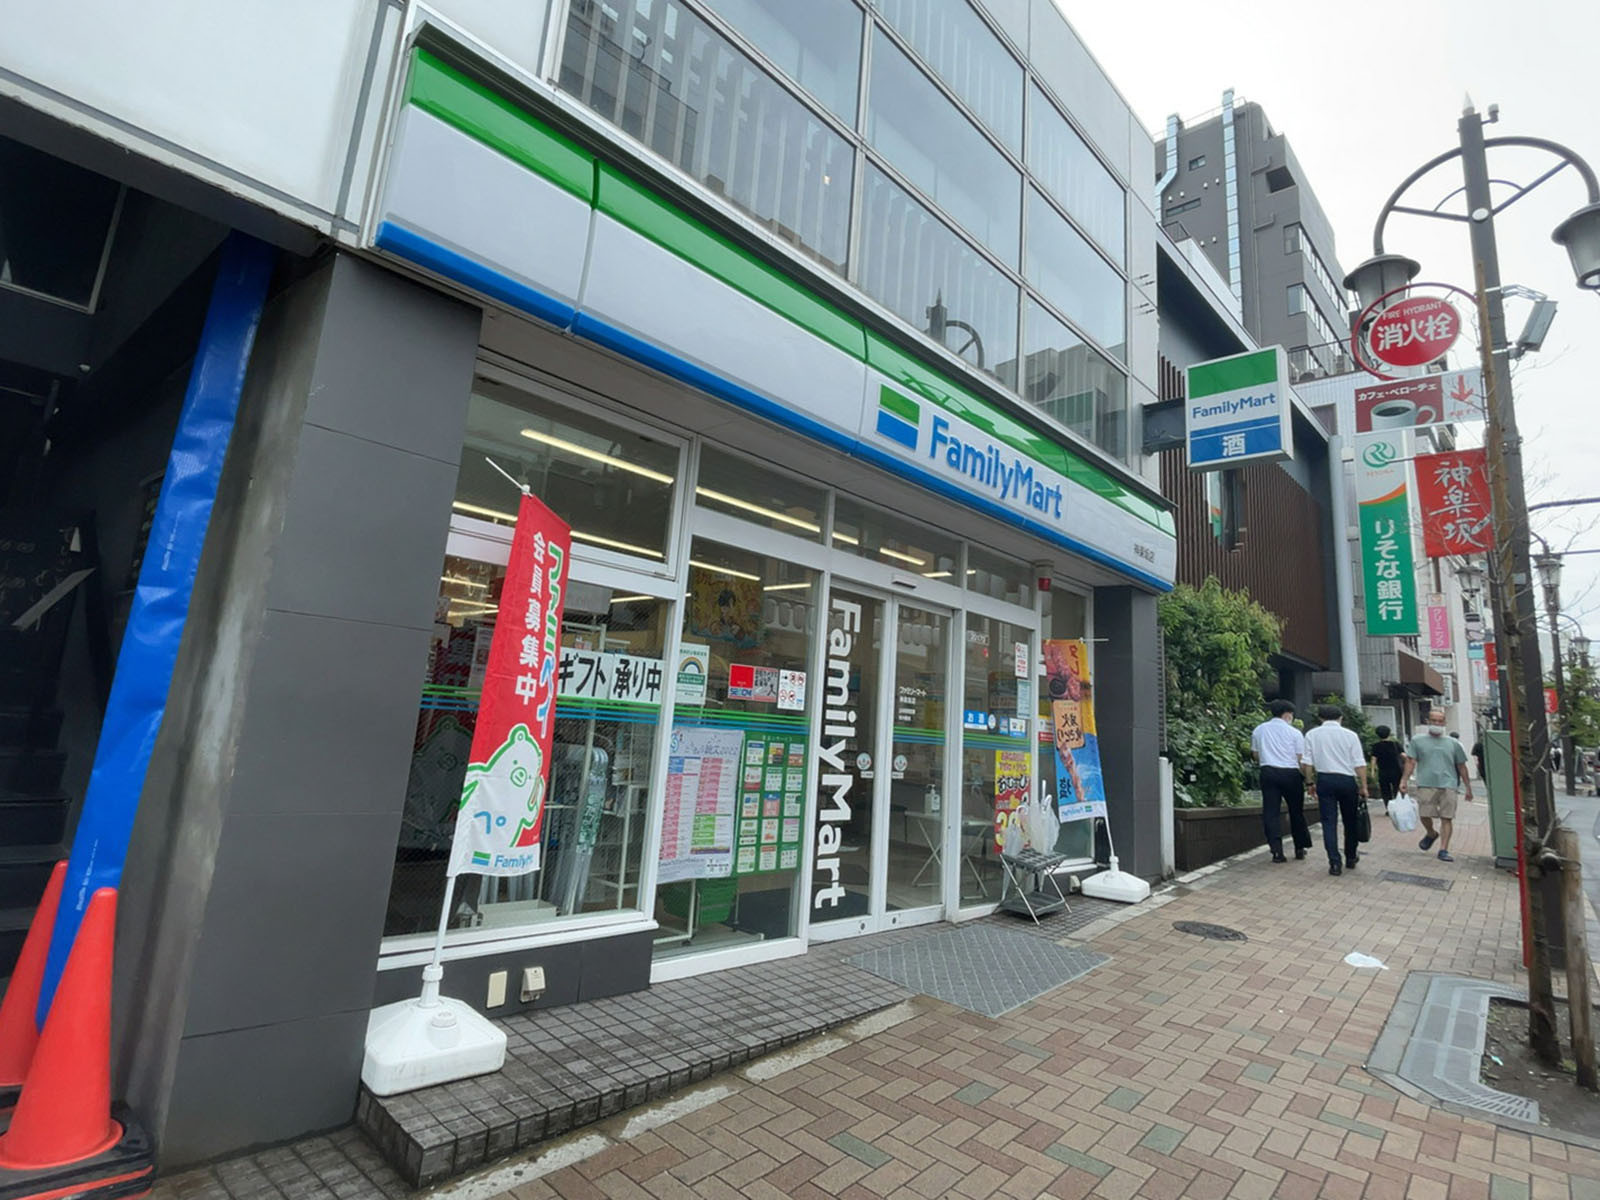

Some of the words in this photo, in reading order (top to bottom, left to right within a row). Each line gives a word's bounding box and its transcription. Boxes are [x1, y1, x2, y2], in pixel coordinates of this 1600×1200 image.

[1377, 312, 1453, 351] 消火栓
[1383, 309, 1400, 321] FIRE
[1403, 301, 1442, 316] HYDRANT
[1192, 393, 1276, 419] FamilyMart
[930, 414, 1063, 519] FamilyMart
[1222, 433, 1246, 457] 酒
[1430, 460, 1489, 550] 神楽坂
[1373, 519, 1404, 621] りそな銀行
[815, 598, 862, 909] FamilyMart
